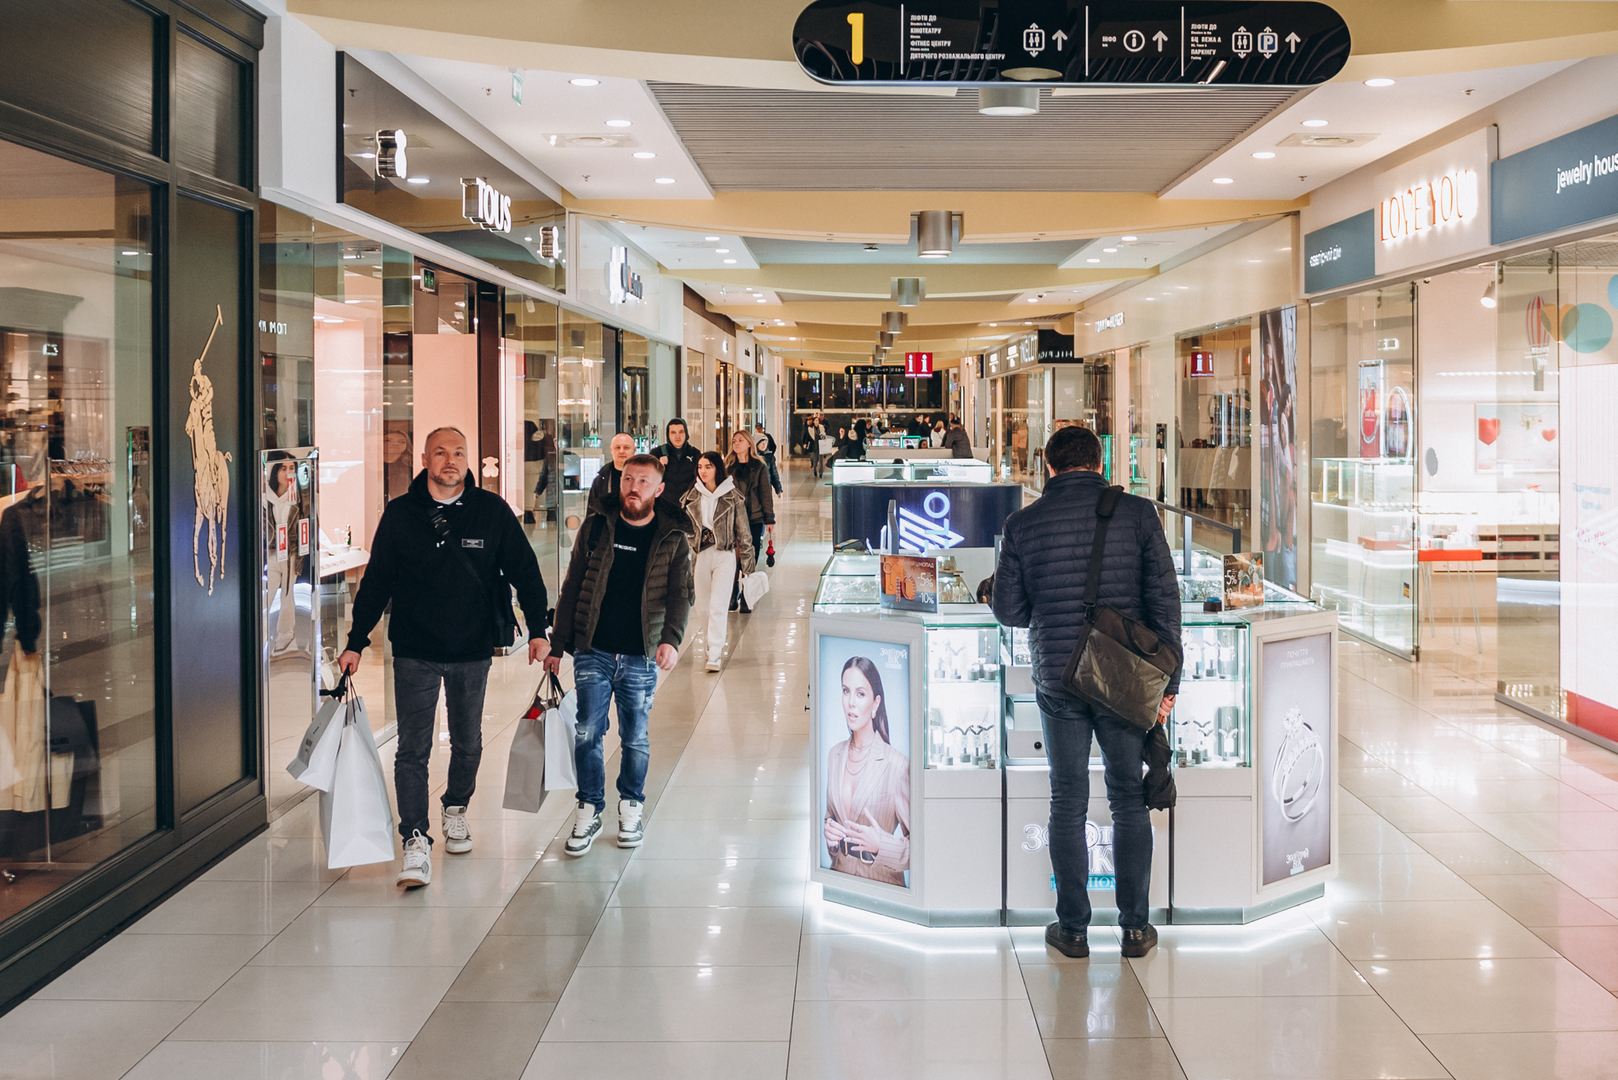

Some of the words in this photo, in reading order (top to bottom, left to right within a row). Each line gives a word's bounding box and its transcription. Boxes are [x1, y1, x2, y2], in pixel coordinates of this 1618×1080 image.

[910, 14, 927, 22] ЛІФТИ
[928, 14, 937, 22] ДО
[1208, 23, 1217, 31] ДО
[846, 12, 864, 65] 1
[930, 40, 951, 48] ЦЕНТРУ
[985, 53, 1005, 61] ЦЕНТРУ
[1556, 160, 1593, 194] jewelry
[475, 176, 512, 234] TOUS
[1380, 185, 1428, 243] LOVE
[1428, 168, 1478, 226] YOU
